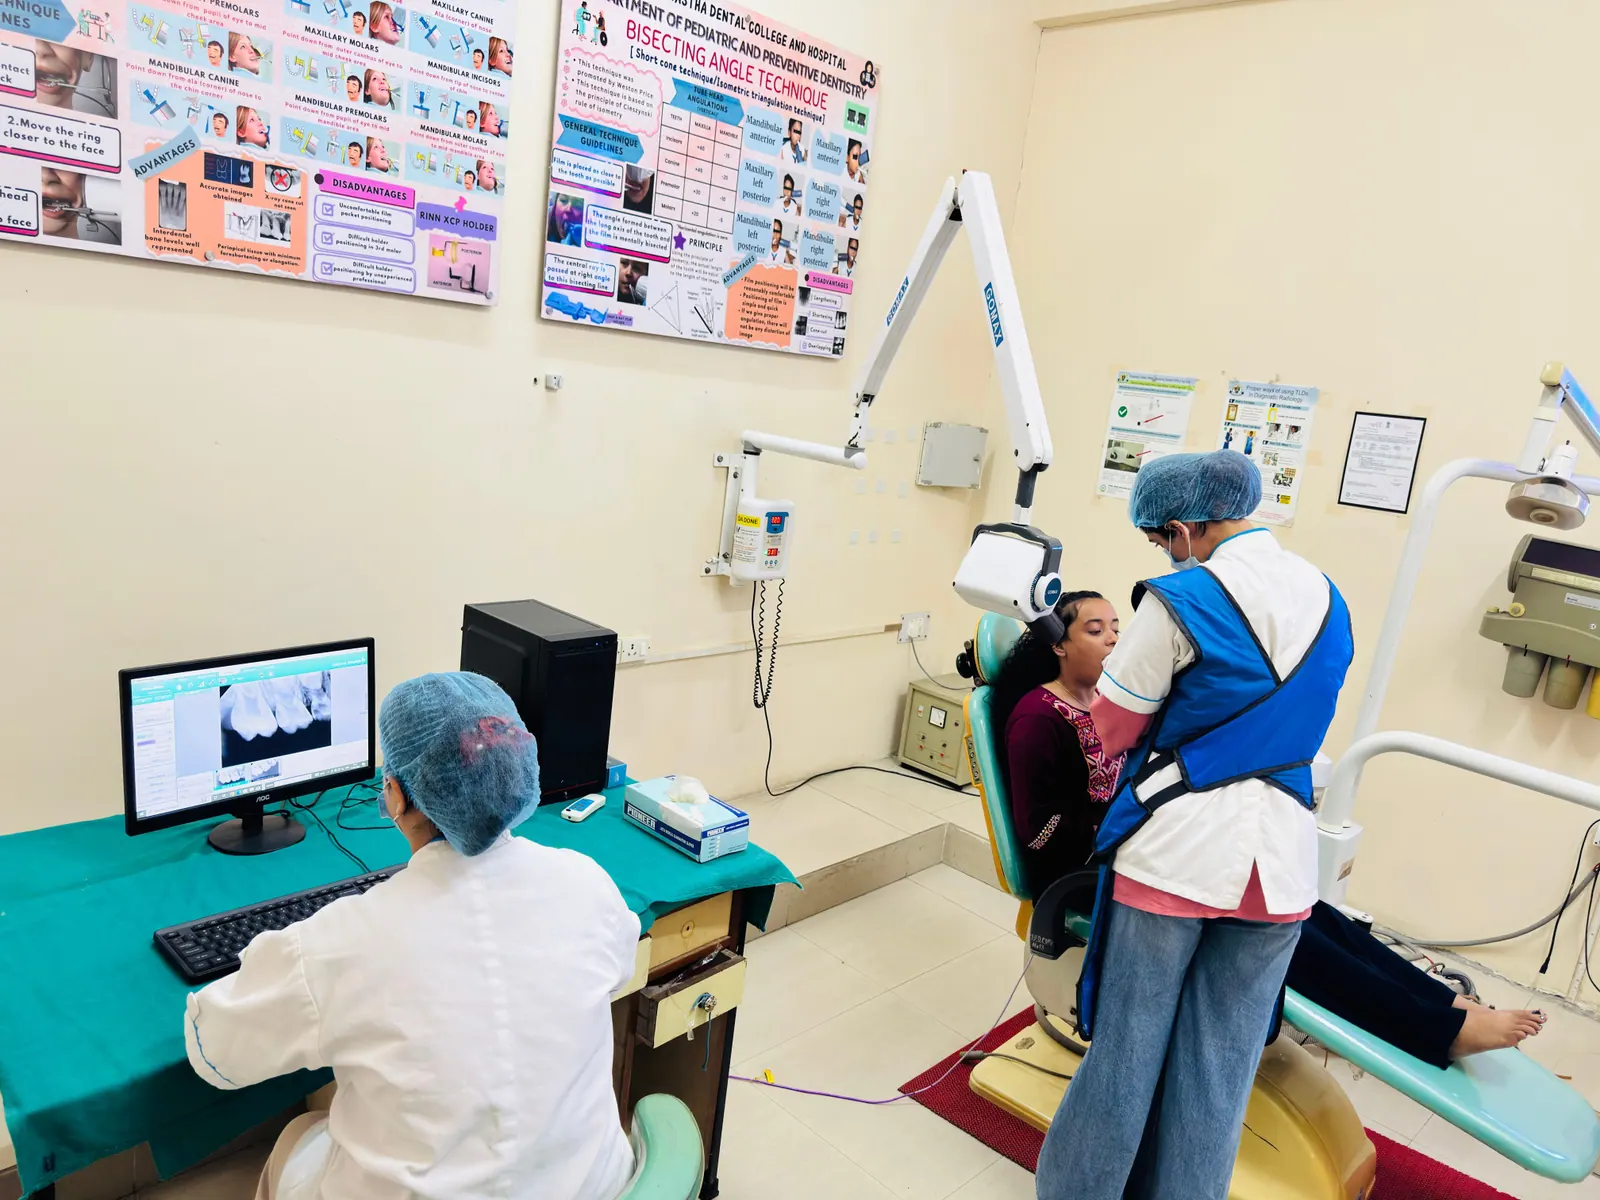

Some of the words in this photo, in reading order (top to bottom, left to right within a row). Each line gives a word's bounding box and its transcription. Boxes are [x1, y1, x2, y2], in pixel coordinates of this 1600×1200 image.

[0, 0, 60, 20] HNIQUE
[432, 0, 469, 16] MAXILLARY
[470, 12, 494, 25] CANINE
[2, 12, 31, 29] NES
[304, 25, 347, 43] MAXILLARY
[349, 38, 379, 53] MOLARS
[709, 4, 746, 30] DENTAL
[748, 21, 788, 47] COLLEGE
[789, 38, 806, 54] AND
[808, 44, 847, 71] HOSPITAL
[626, 19, 706, 67] BISECTING
[709, 52, 754, 84] ANGLE
[758, 69, 828, 110] TECHNIQUE
[666, 12, 683, 29] OF
[684, 18, 739, 51] PEDIATRIC
[739, 40, 761, 59] AND
[763, 49, 819, 82] PREVENTIVE
[820, 72, 867, 100] DENTISTRY
[149, 58, 205, 79] MANDIBULAR
[208, 73, 240, 87] CANINE
[428, 61, 470, 78] MANDIBULAR
[472, 73, 501, 87] INCISORS
[578, 59, 590, 68] This
[592, 63, 621, 78] technique
[577, 69, 606, 83] promoted
[608, 78, 615, 87] by
[616, 81, 638, 93] Weston
[639, 90, 653, 99] Price
[636, 48, 658, 64] Short
[660, 59, 677, 71] cone
[752, 91, 792, 111] triangulation
[576, 89, 586, 97] the
[587, 93, 614, 107] principle
[577, 79, 589, 88] This
[591, 83, 620, 98] technique
[628, 94, 644, 105] based
[693, 86, 708, 97] TUBE
[709, 91, 724, 102] HEAD
[295, 94, 343, 112] MANDIBULAR
[346, 107, 387, 123] PREMOLARS
[575, 100, 587, 108] rule
[589, 102, 595, 110] of
[597, 105, 622, 119] isometry
[687, 94, 728, 113] ANGULATIONS
[8, 116, 52, 132] 2.Move
[56, 126, 74, 137] the
[78, 131, 101, 144] ring
[746, 115, 782, 133] Mandibular
[4, 128, 40, 142] closer
[44, 136, 56, 146] to
[60, 139, 78, 150] the
[82, 144, 105, 156] face
[420, 124, 460, 140] MANDIBULAR
[462, 134, 488, 146] MOLARS
[564, 120, 597, 136] GENERAL
[600, 129, 638, 148] TECHNIQUE
[750, 131, 776, 145] anterior
[581, 137, 624, 156] GUIDELINES
[816, 138, 842, 155] Maxillary
[134, 139, 196, 178] ADVANTAGES
[817, 152, 839, 165] anterior
[745, 162, 774, 180] Maxillary
[332, 178, 407, 201] DISADVANTAGES
[753, 178, 764, 188] left
[811, 182, 838, 198] Maxillary
[0, 189, 28, 202] head
[742, 190, 771, 203] posterior
[816, 196, 831, 207] right
[8, 216, 32, 228] face
[420, 211, 441, 222] RINN
[444, 215, 460, 225] XCP
[463, 218, 494, 232] HOLDER
[593, 210, 603, 218] The
[604, 213, 620, 223] angle
[622, 216, 642, 227] formed
[644, 221, 666, 233] between
[737, 214, 772, 229] Mandibular
[808, 208, 834, 220] posterior
[152, 228, 192, 238] Interdental
[598, 220, 611, 230] long
[613, 224, 625, 232] axis
[644, 231, 658, 240] tooth
[748, 229, 758, 240] left
[803, 230, 834, 245] Mandibular
[145, 234, 162, 243] bone
[163, 237, 184, 247] levels
[152, 243, 193, 255] represented
[600, 230, 611, 239] film
[619, 235, 643, 246] mentally
[645, 240, 667, 250] bisected
[689, 238, 723, 252] PRINCIPLE
[738, 242, 766, 254] posterior
[810, 245, 824, 255] right
[566, 259, 588, 268] central
[723, 255, 755, 284] ADVANTAGES
[803, 257, 828, 269] posterior
[547, 265, 568, 275] passed
[578, 270, 593, 279] right
[594, 273, 610, 282] angle
[556, 276, 568, 284] this
[570, 278, 596, 290] bisecting
[597, 282, 608, 290] line
[813, 276, 849, 290] DISADVANTAGES
[986, 287, 1002, 344] GOMAX
[256, 794, 270, 803] AOC
